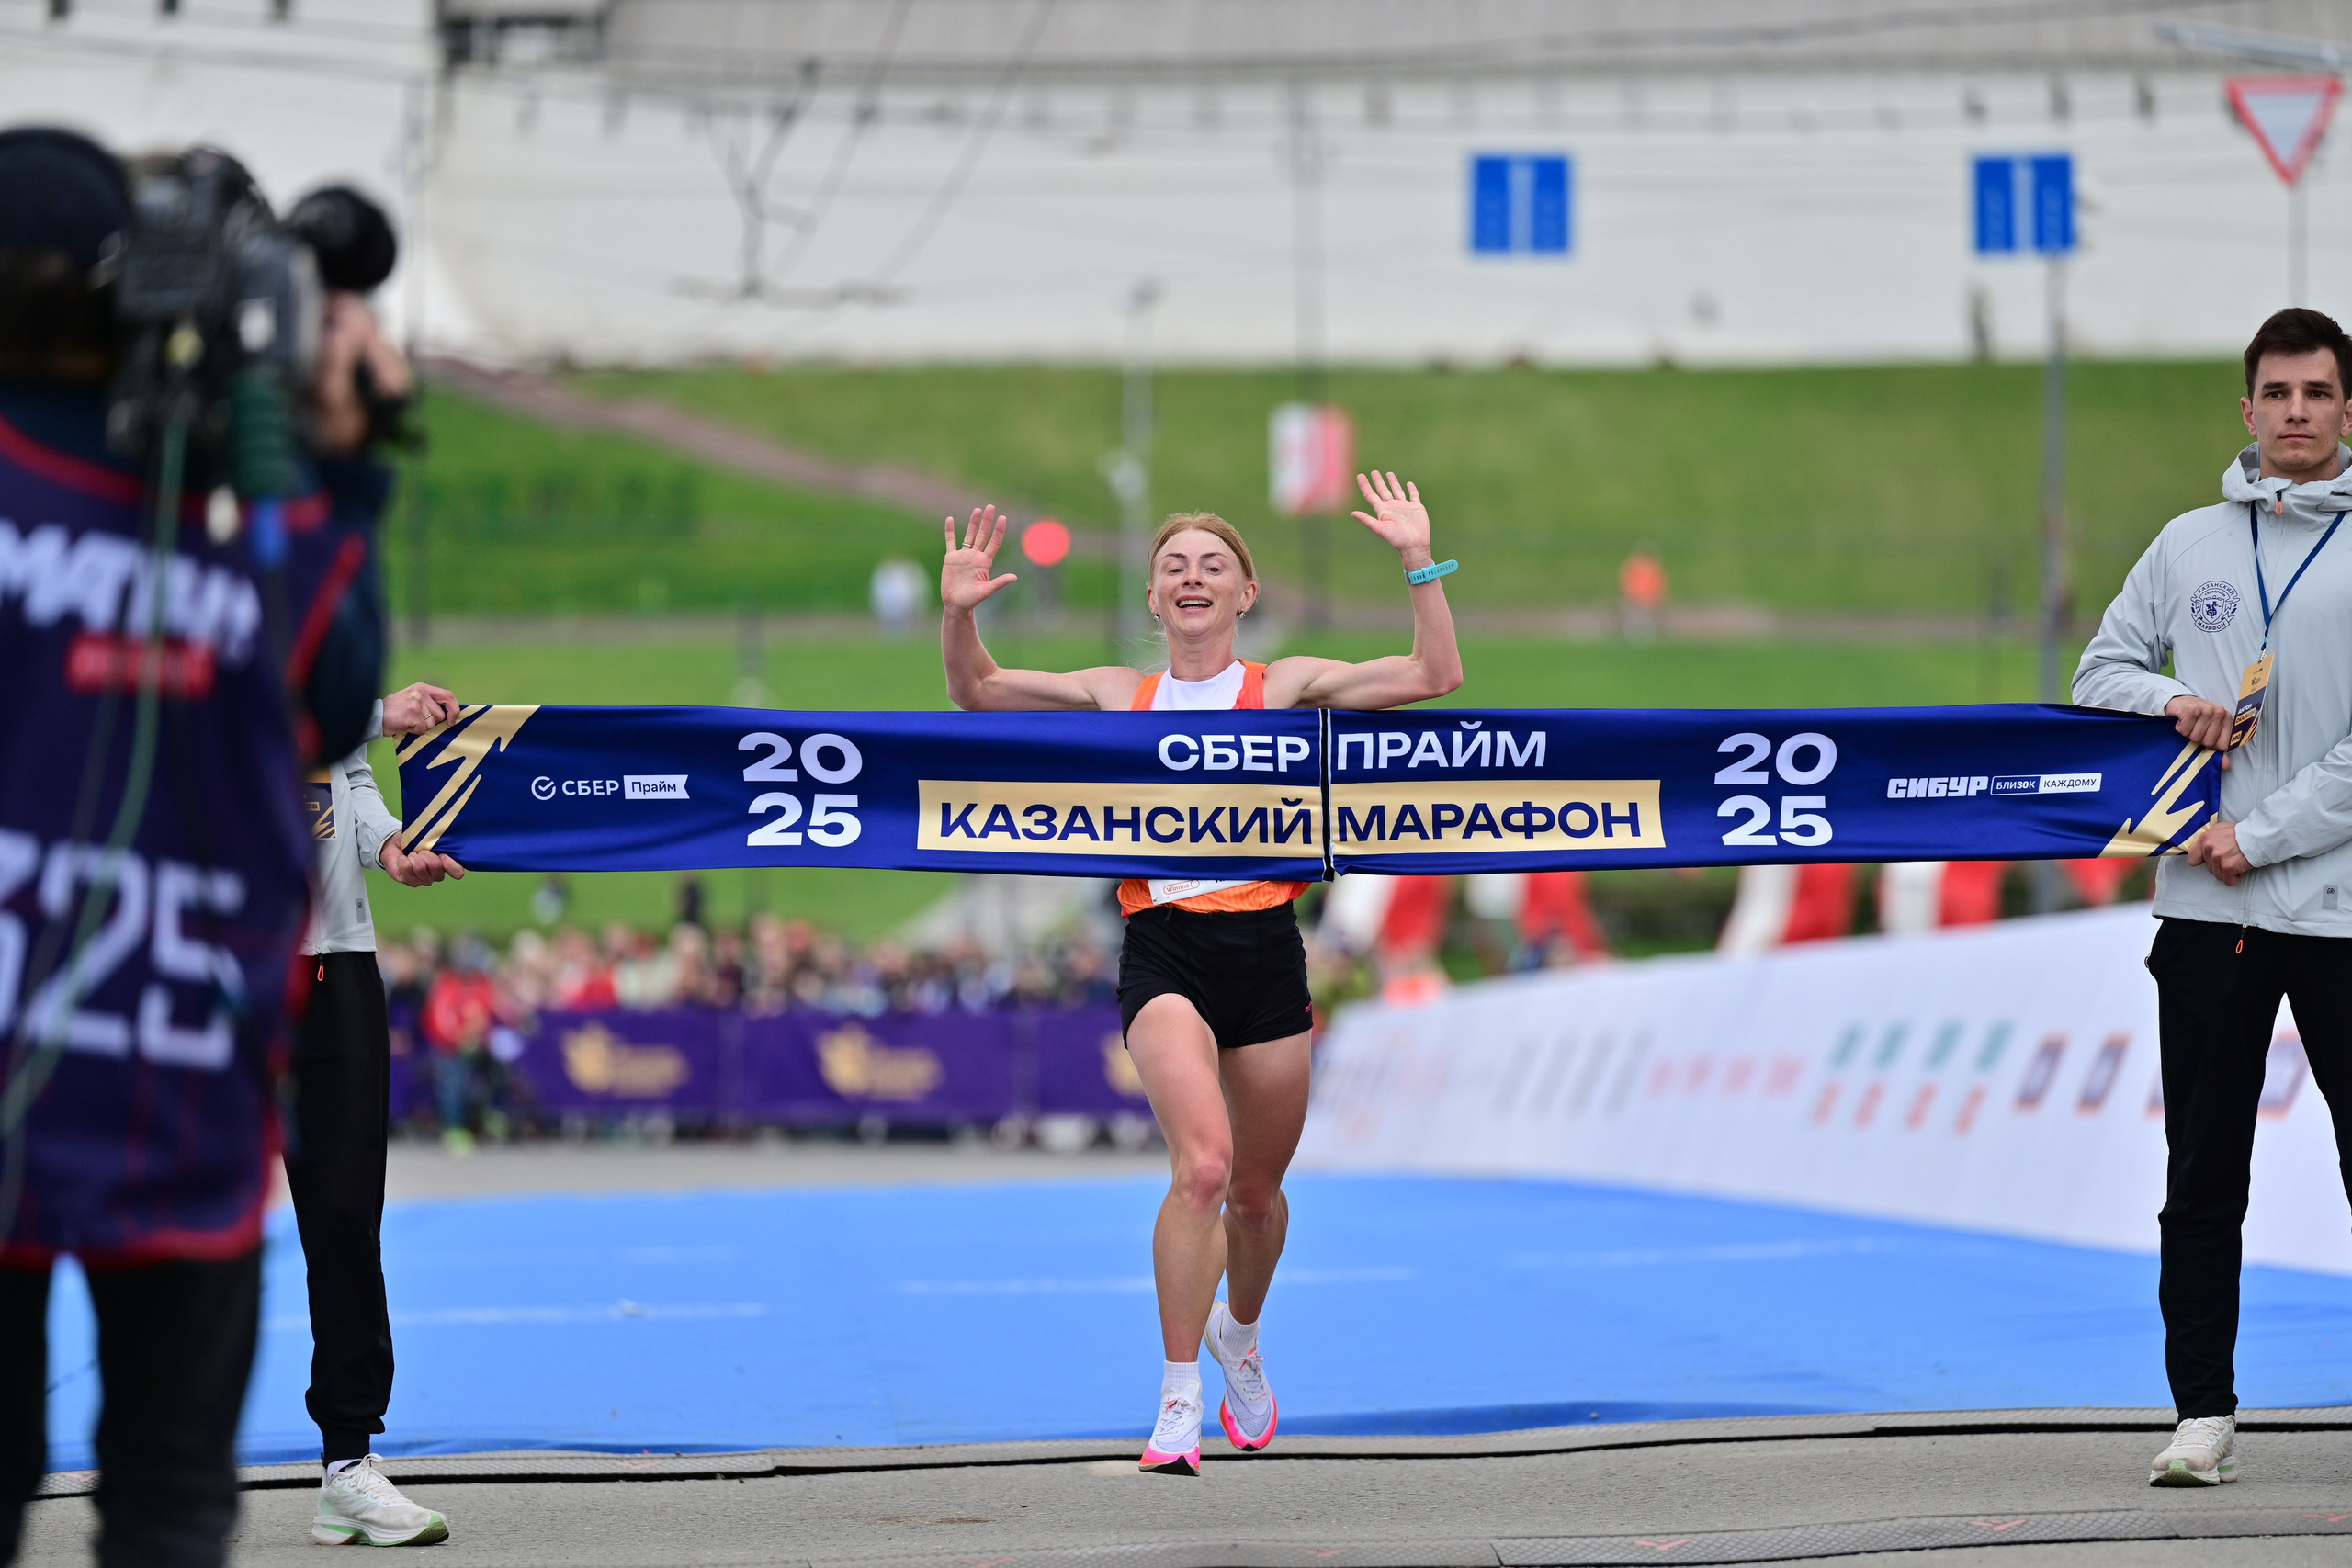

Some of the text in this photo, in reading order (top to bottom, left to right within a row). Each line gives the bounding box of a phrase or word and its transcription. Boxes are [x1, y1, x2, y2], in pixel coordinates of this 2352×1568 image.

[2198, 582, 2234, 596] КАЗАНСКИЙ
[2197, 620, 2226, 631] МАРАФОН
[738, 732, 863, 784] 20
[1159, 721, 1546, 772] СБЕР ПРАЙМ
[1713, 732, 1838, 785] 20
[561, 780, 677, 795] СБЕР Прайм
[1886, 776, 2097, 799] СИБУР БЛИЗОК КАЖДОМУ
[746, 792, 862, 848] 25
[940, 797, 1641, 845] КАЗАНСКИЙ МАРАФОН
[1716, 795, 1833, 847] 25
[1166, 884, 1190, 893] Winline
